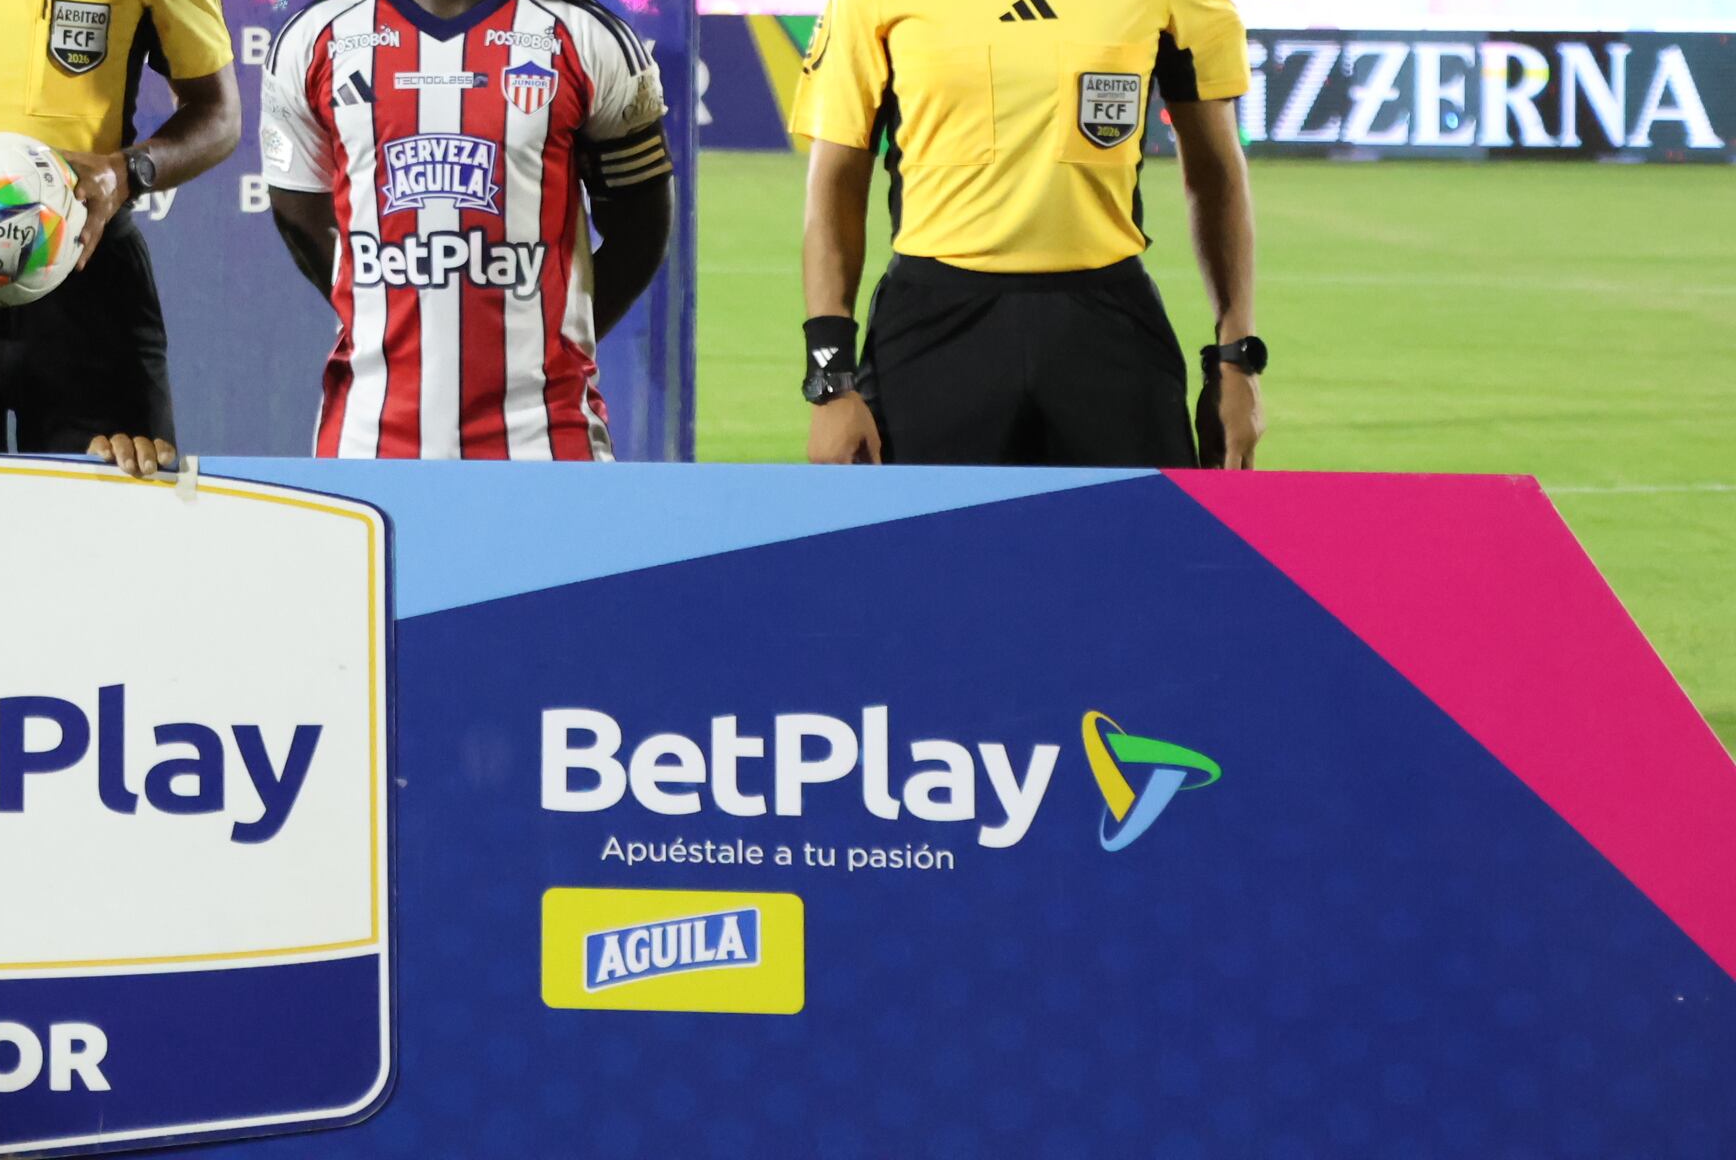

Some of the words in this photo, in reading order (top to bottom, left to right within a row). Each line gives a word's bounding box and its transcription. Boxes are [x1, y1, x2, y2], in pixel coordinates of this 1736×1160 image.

[56, 6, 107, 25] ÁRBITRO
[63, 29, 95, 48] FCF
[511, 79, 548, 89] JUNIOR
[1086, 76, 1138, 92] ÁRBITRO
[1093, 102, 1127, 121] FCF
[394, 163, 486, 200] AGUILA
[349, 228, 547, 299] BetPlay
[540, 704, 1062, 849] BetPlay
[600, 835, 765, 866] Apuéstale
[774, 844, 794, 867] a
[804, 841, 837, 868] tu
[848, 840, 956, 872] pasión
[594, 913, 750, 984] AGUILA
